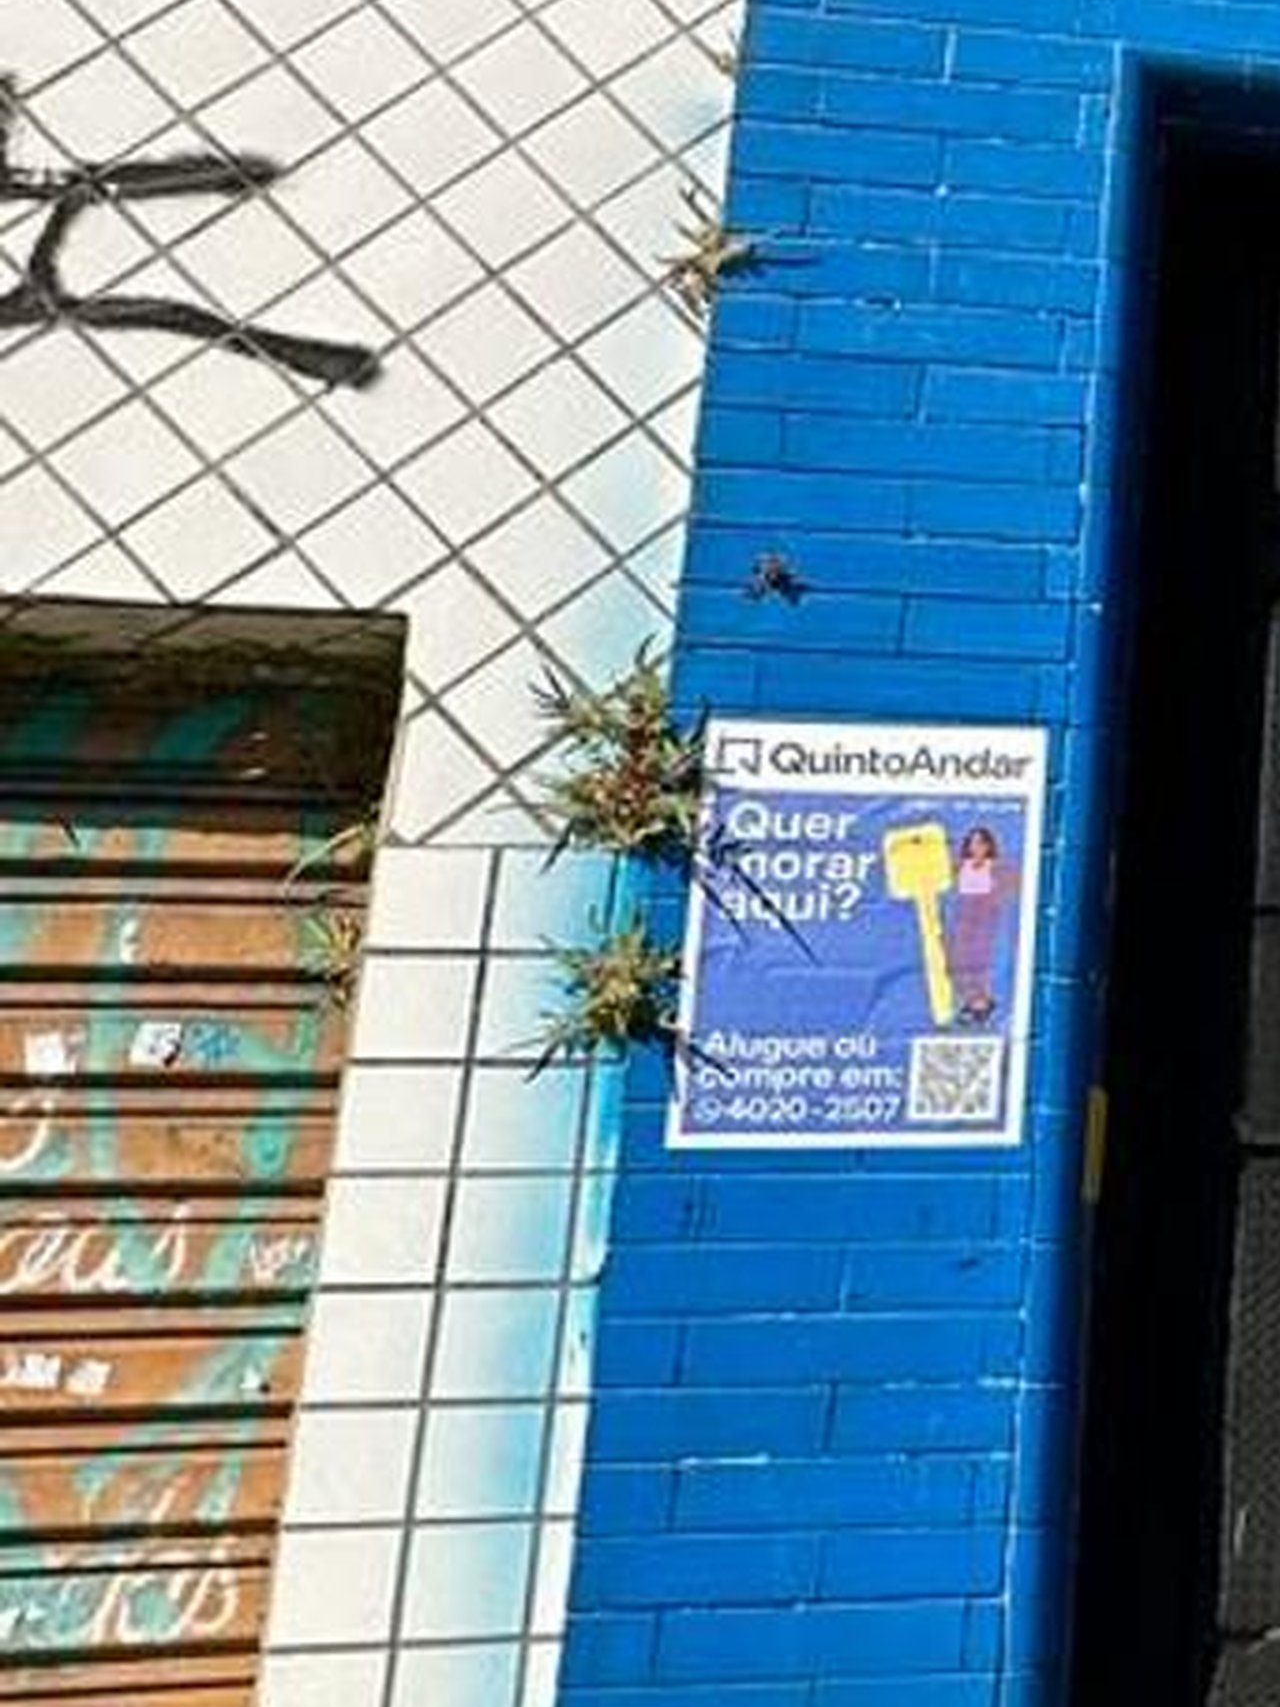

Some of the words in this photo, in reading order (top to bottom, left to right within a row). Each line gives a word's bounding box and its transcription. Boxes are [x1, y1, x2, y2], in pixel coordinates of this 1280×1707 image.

[769, 742, 1034, 780] QuintoAndar
[727, 800, 858, 841] Quer
[719, 882, 862, 929] aqui?
[702, 1030, 826, 1064] Alugue
[834, 1034, 876, 1059] ou
